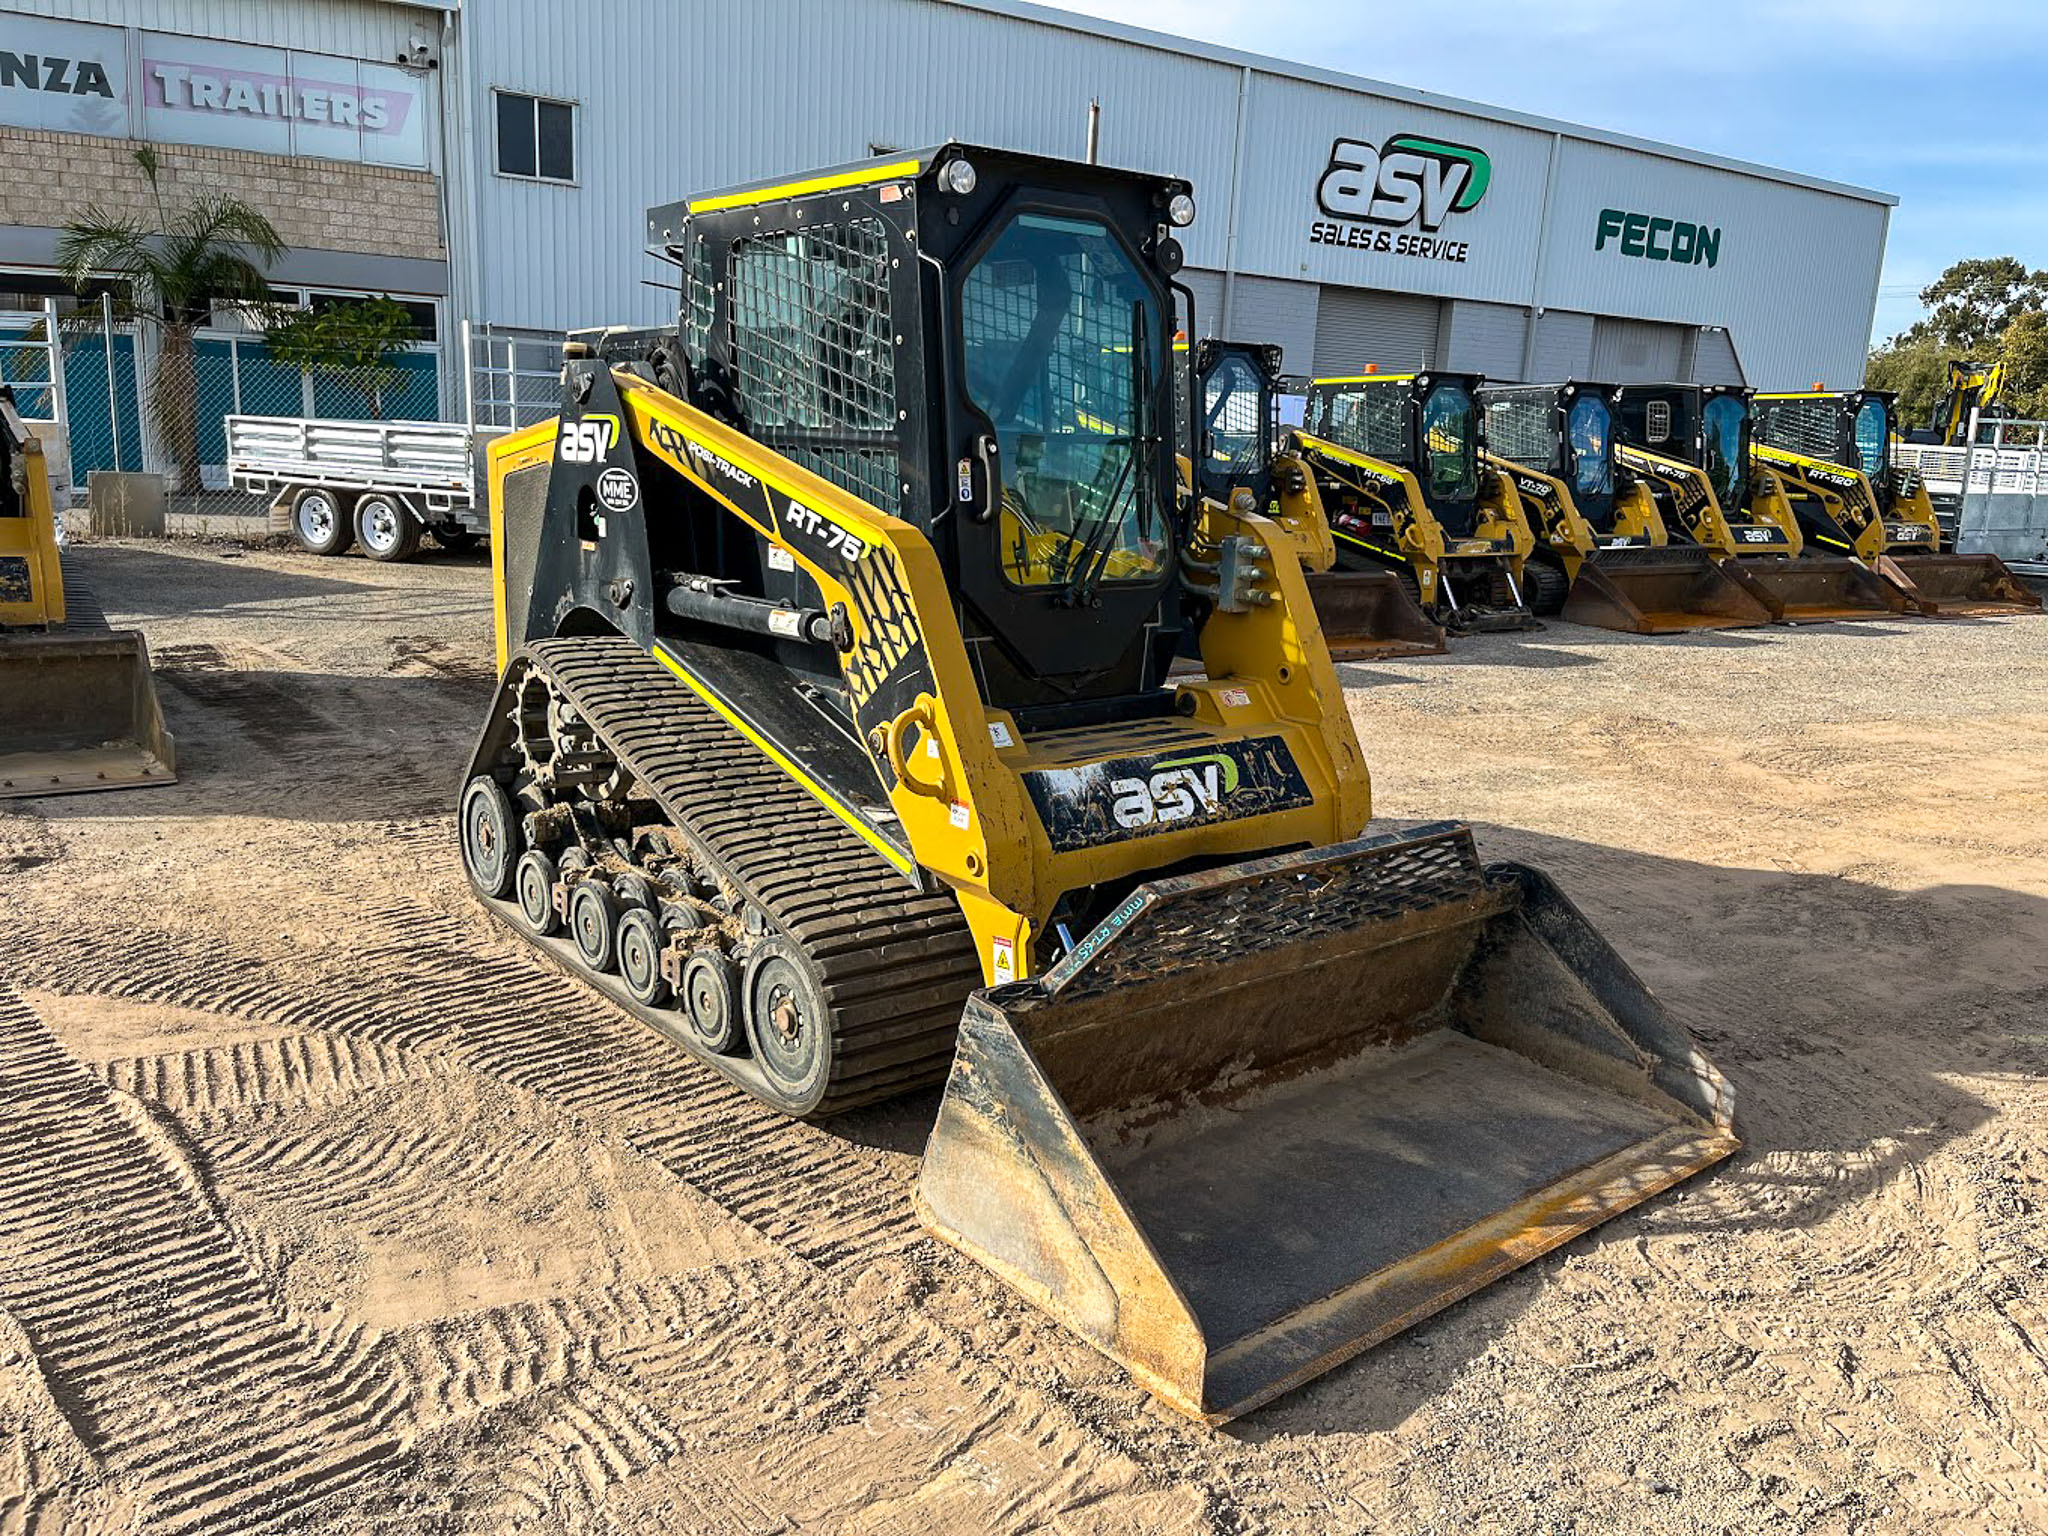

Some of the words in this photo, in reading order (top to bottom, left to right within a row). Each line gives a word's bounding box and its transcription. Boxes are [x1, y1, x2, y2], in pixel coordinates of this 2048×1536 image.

[154, 65, 390, 129] TRAILERS
[1373, 231, 1392, 252] &
[1395, 234, 1470, 263] SERVICE
[1595, 208, 1721, 268] FECON
[602, 480, 633, 499] MME
[786, 500, 862, 562] RT-75
